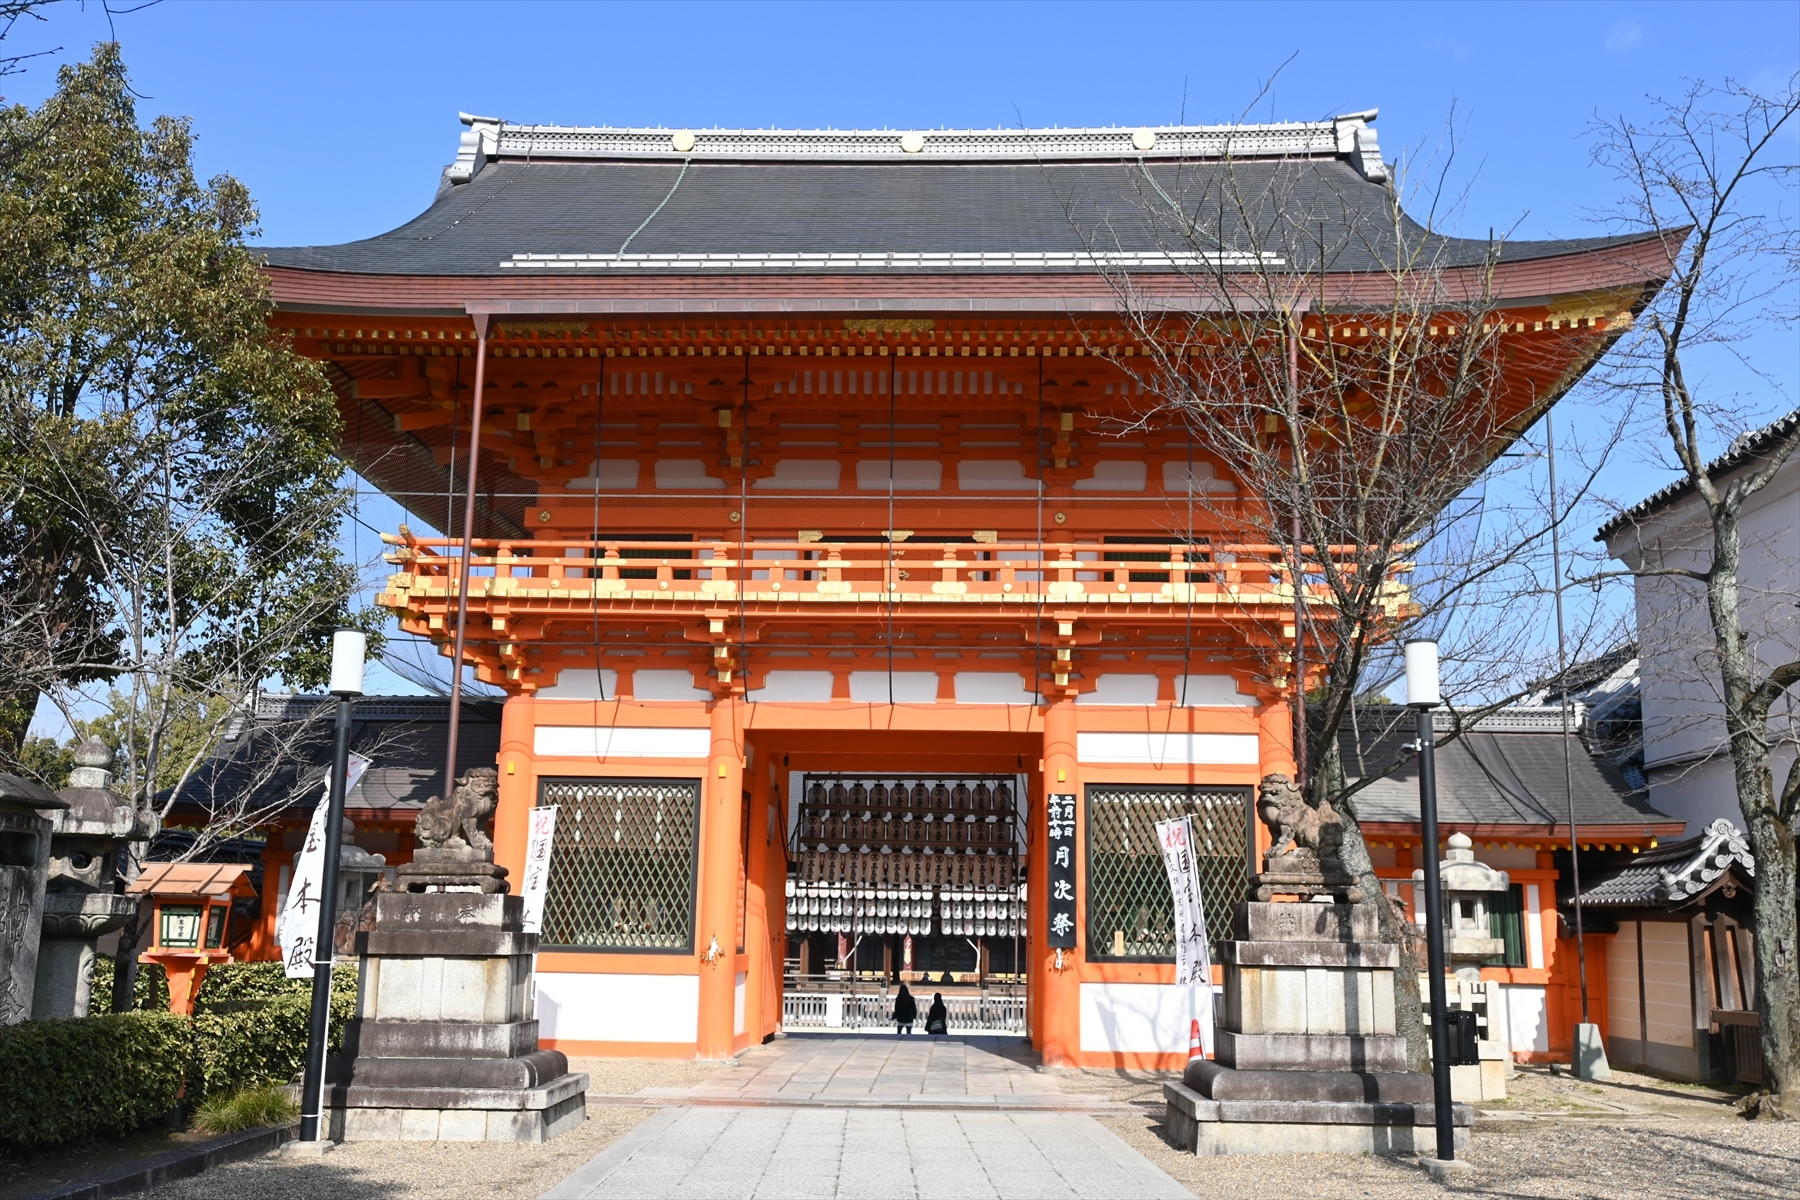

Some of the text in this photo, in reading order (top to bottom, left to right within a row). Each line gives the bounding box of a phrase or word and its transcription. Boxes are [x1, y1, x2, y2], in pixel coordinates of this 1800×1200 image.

[1048, 794, 1063, 840] 午前十時
[1062, 795, 1075, 837] 二月一日
[1050, 845, 1075, 938] 月次祭
